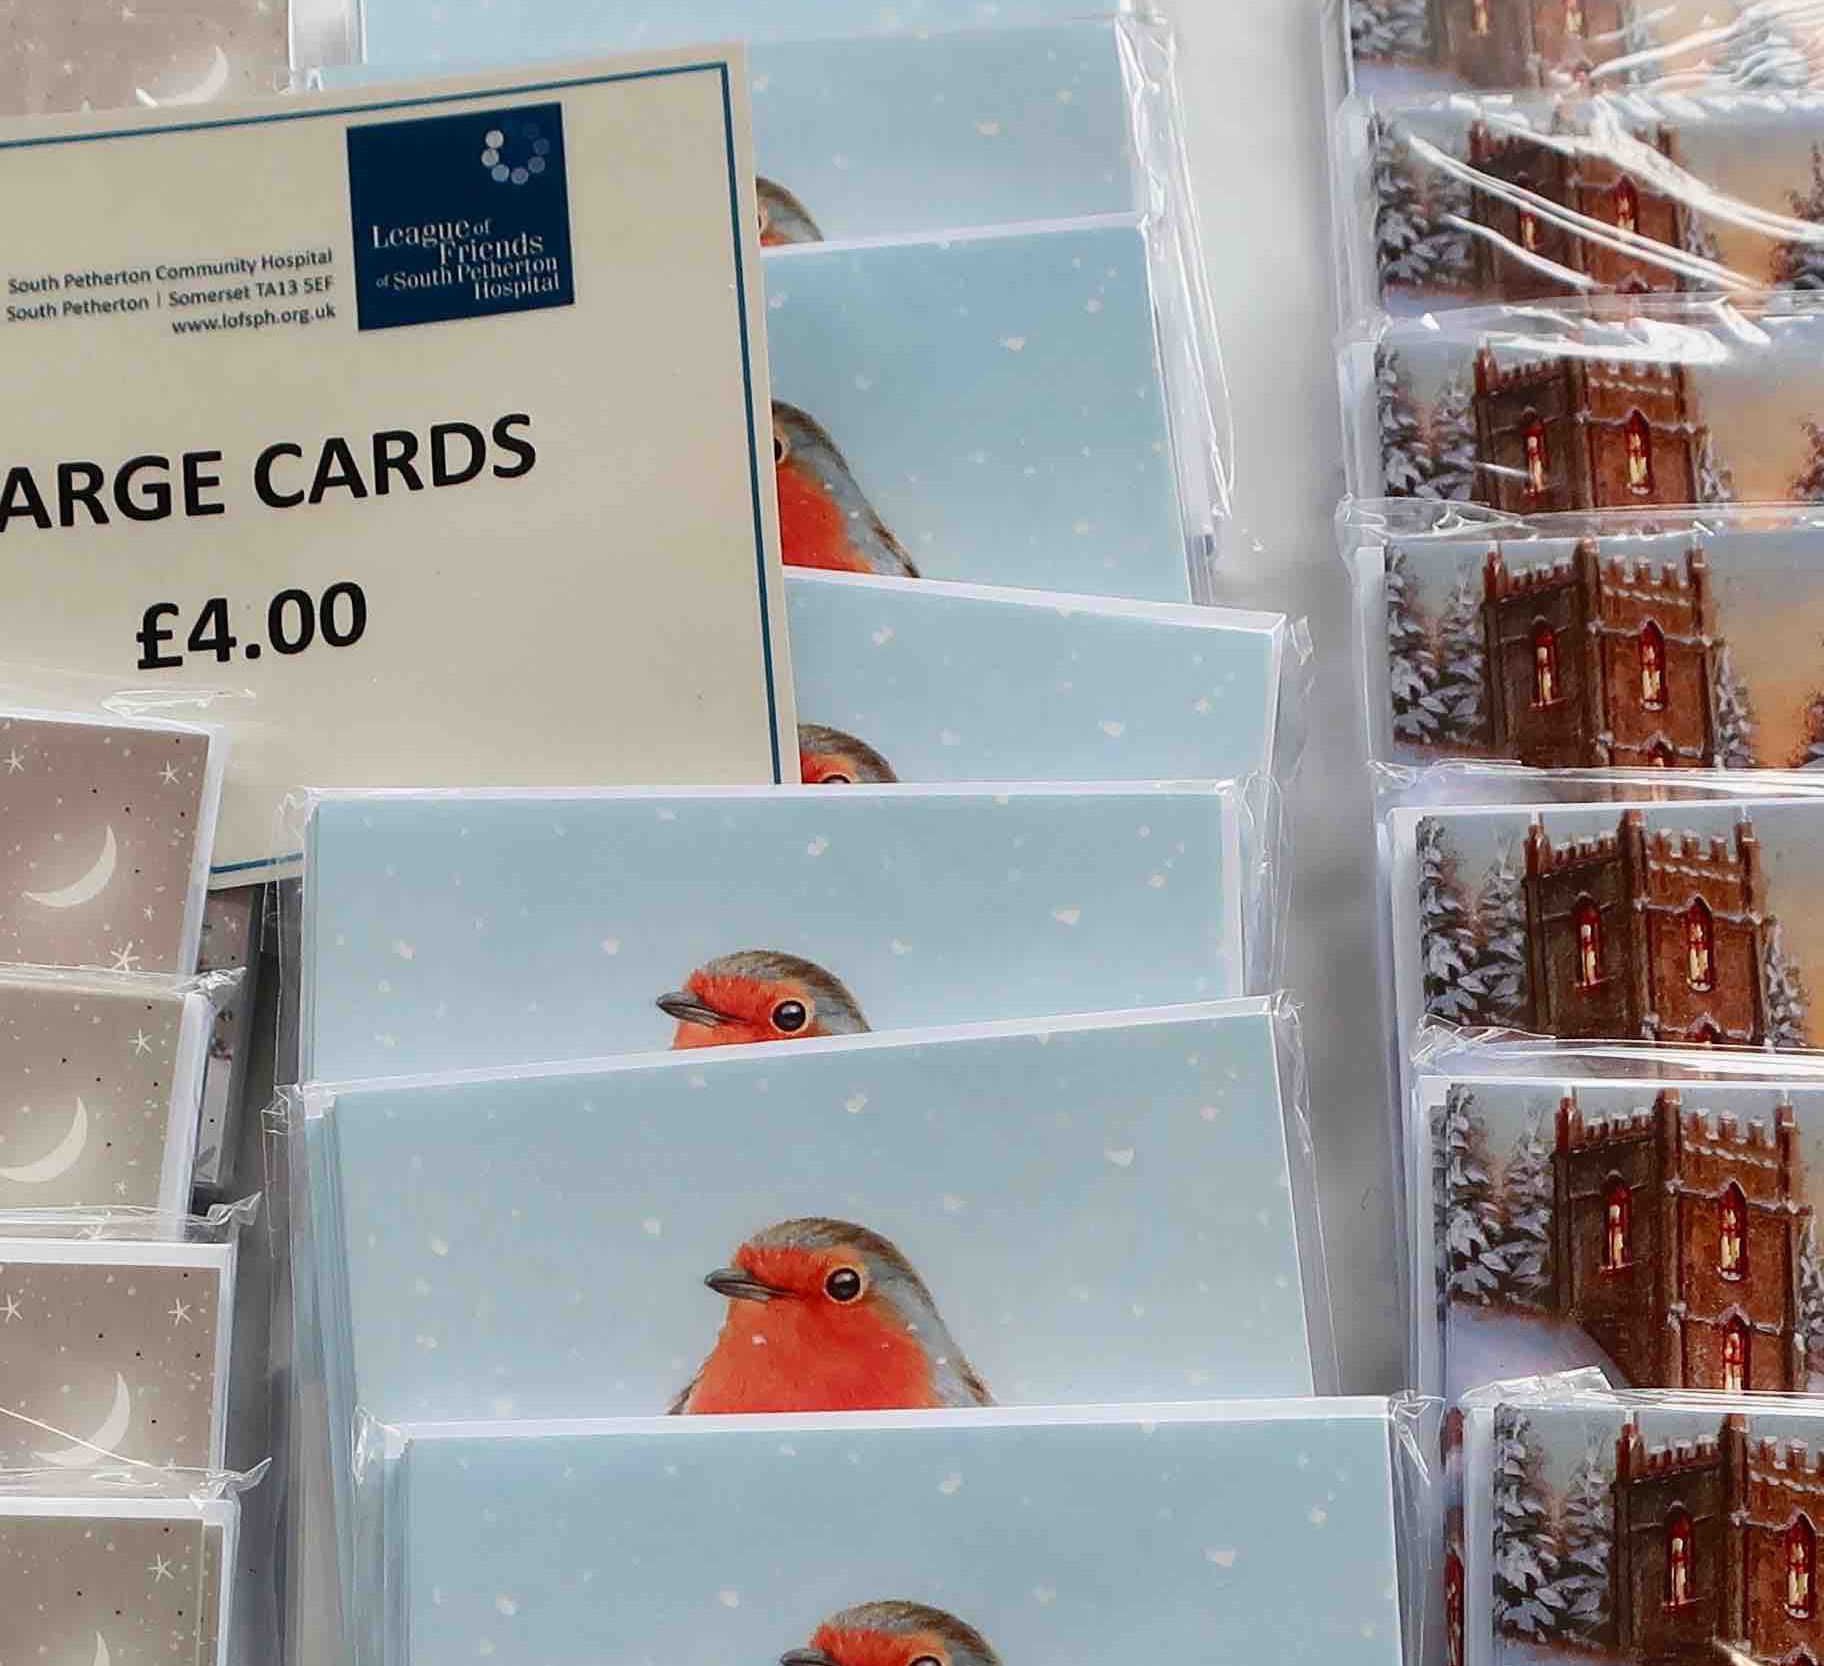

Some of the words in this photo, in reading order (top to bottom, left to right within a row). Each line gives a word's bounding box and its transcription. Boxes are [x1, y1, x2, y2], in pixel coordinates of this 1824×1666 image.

[372, 219, 470, 250] League
[473, 218, 492, 236] of
[439, 233, 544, 265] Friends
[8, 275, 60, 295] South
[64, 267, 151, 289] Petherton
[155, 257, 256, 282] Community
[261, 249, 333, 271] Hospital
[375, 272, 389, 288] of
[393, 266, 452, 291] South
[457, 255, 558, 283] Petherton
[475, 273, 560, 300] Hospital
[6, 302, 57, 322] South
[62, 295, 149, 317] Petherton
[168, 284, 250, 307] Somerset
[255, 279, 298, 298] TA13
[304, 275, 334, 293] 5EF
[171, 302, 336, 335] www.lofsph.org.uk
[253, 413, 537, 508] CARDS
[136, 581, 367, 670] £4.00
